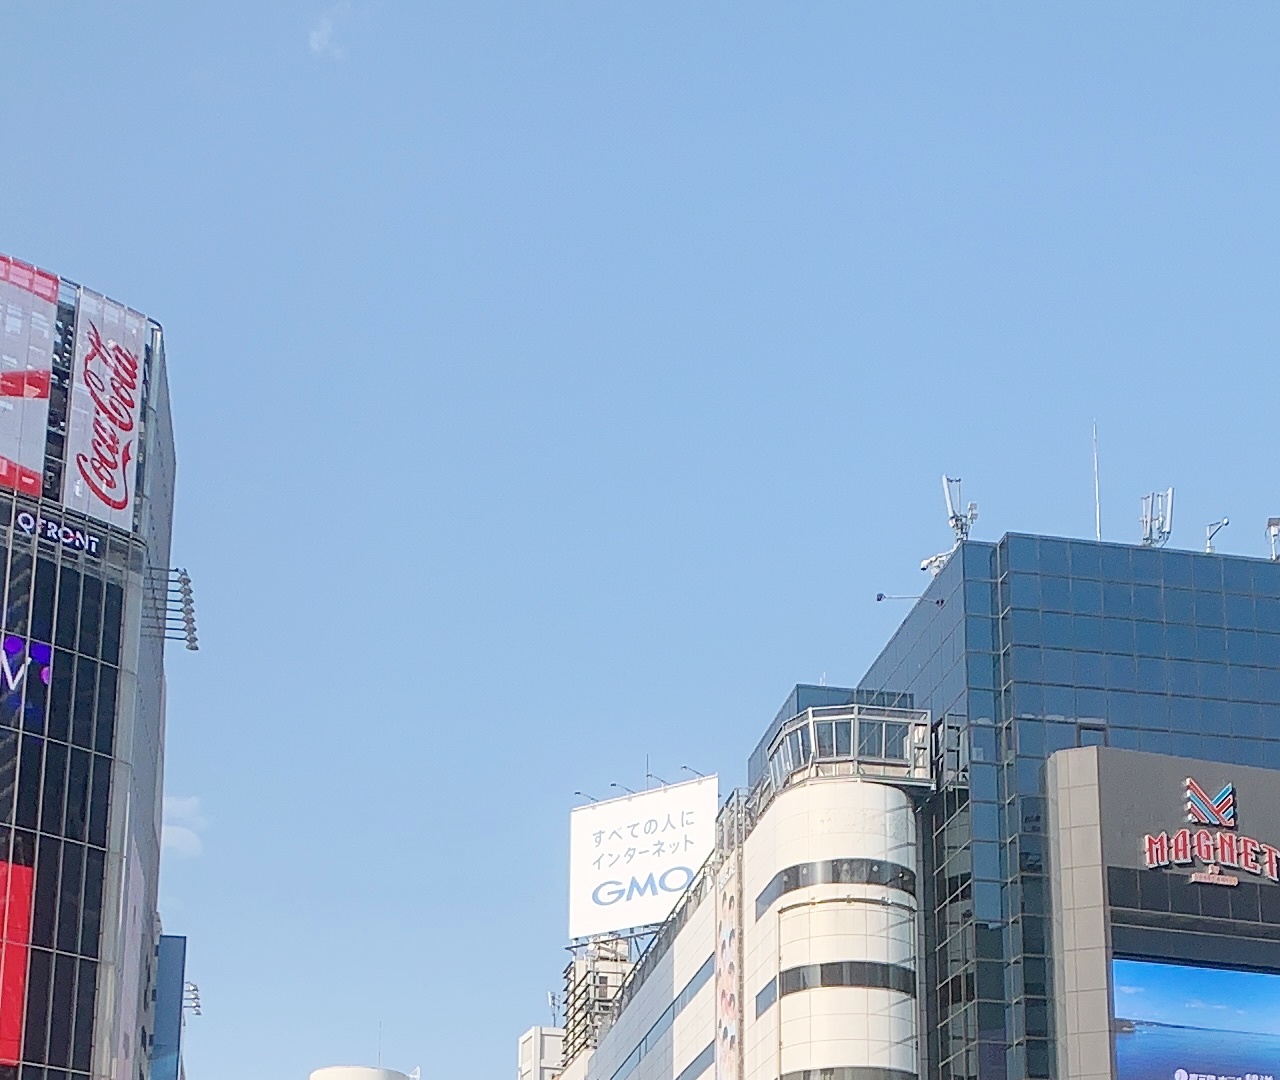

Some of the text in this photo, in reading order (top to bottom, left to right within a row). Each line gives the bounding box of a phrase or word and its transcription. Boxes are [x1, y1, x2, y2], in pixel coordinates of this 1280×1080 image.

[76, 318, 140, 511] Coca-Cola
[16, 512, 101, 556] QFRONT
[592, 811, 695, 848] すべての人に
[592, 835, 695, 871] インターネット
[591, 866, 694, 906] GMO
